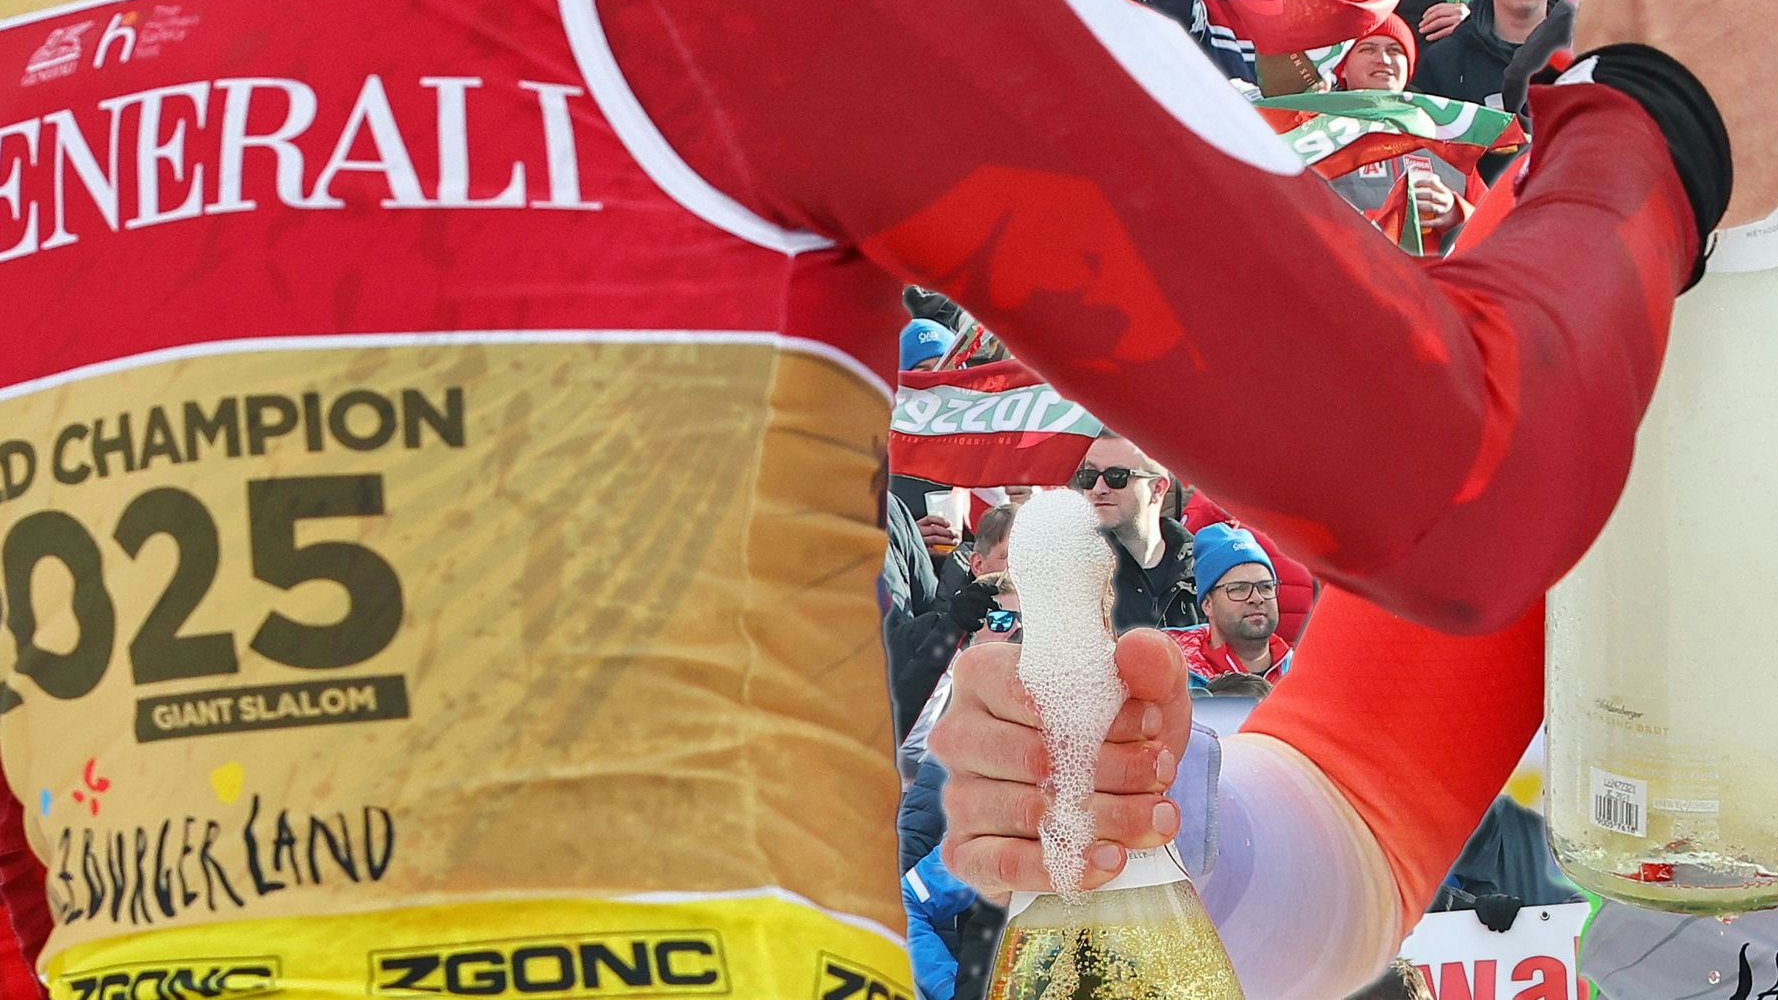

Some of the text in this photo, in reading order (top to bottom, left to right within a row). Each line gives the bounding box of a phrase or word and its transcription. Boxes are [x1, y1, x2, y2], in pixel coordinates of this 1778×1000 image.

[52, 386, 466, 486] CHAMPION
[0, 473, 404, 716] 025
[151, 685, 378, 731] GIANT SLALOM
[243, 794, 395, 896] LAND
[381, 940, 718, 996] ZGONC
